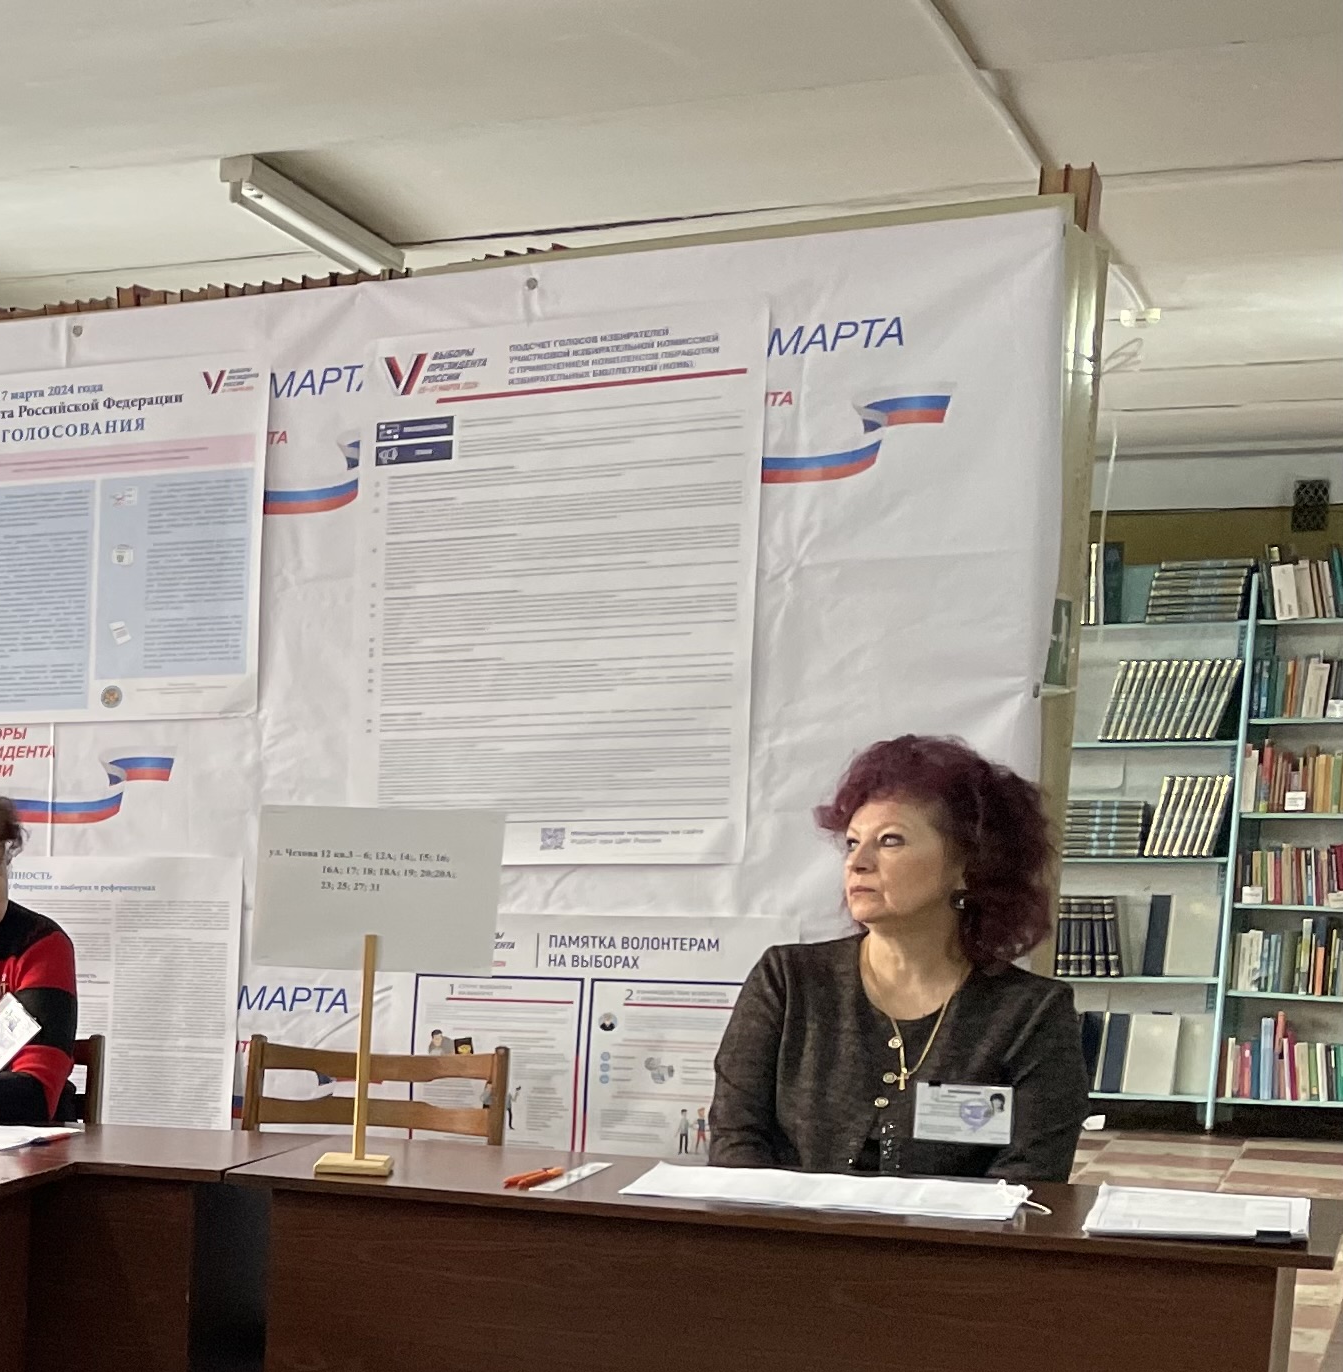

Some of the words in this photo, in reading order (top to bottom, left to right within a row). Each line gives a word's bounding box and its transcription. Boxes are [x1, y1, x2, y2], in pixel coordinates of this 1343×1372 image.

[767, 316, 904, 357] МАРТА
[10, 387, 45, 401] марта
[47, 384, 75, 397] 2024
[77, 383, 104, 395] года
[270, 363, 364, 399] МАРТ
[17, 399, 100, 419] Российской
[102, 392, 185, 410] Федерации
[1, 417, 147, 443] ГОЛОСОВАНИЯ
[285, 848, 318, 857] Чехова
[321, 849, 331, 858] 12
[548, 934, 616, 950] ПАМЯТКА
[621, 936, 720, 952] ВОЛОНТЕРАМ
[548, 954, 566, 967] НА
[572, 955, 640, 969] ВЫБОРАХ
[237, 985, 348, 1014] МАРТА
[625, 988, 634, 1001] 2
